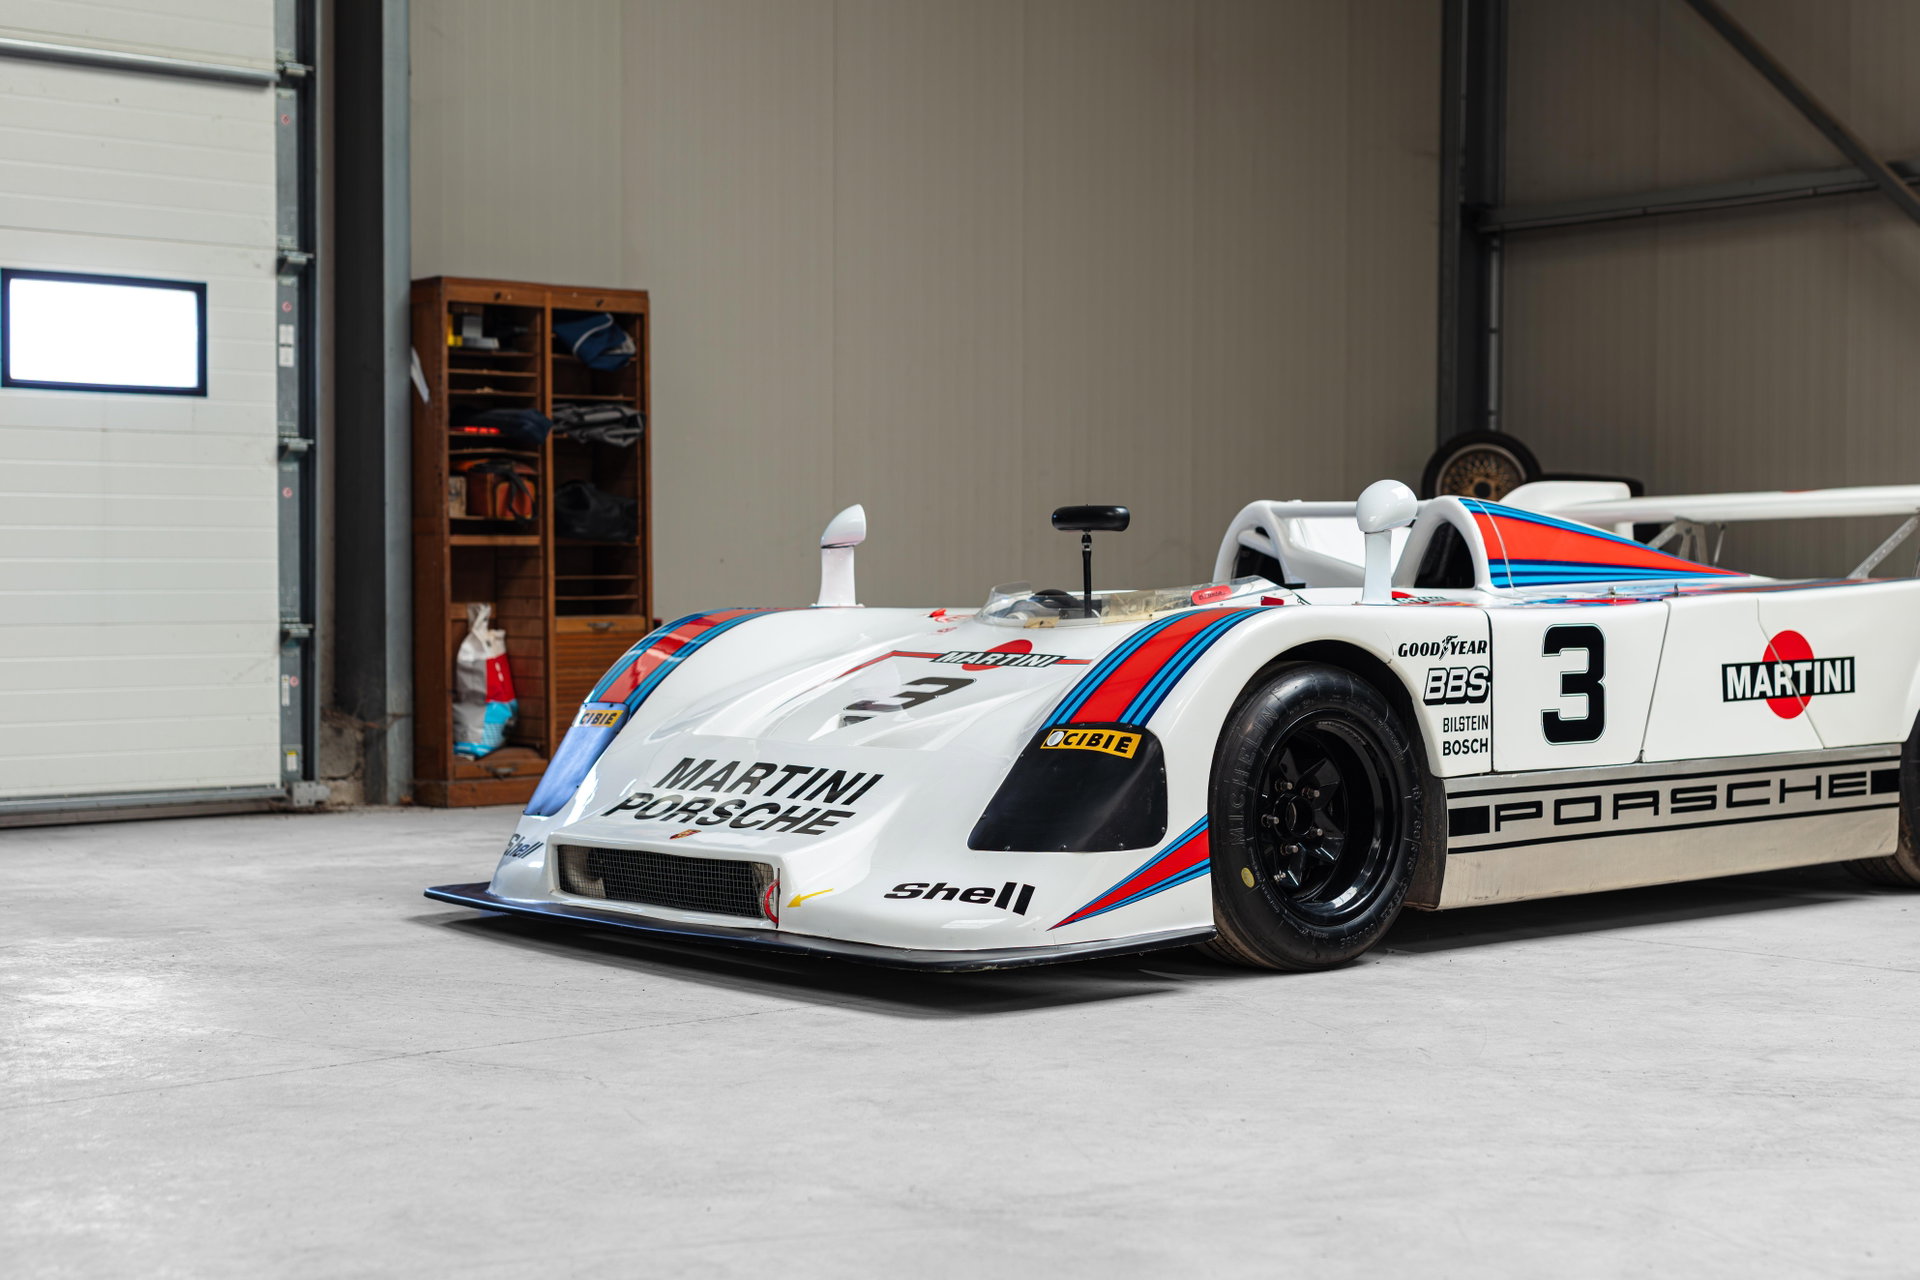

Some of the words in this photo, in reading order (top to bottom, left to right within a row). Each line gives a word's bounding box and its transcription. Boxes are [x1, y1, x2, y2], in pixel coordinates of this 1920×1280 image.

[936, 651, 1054, 668] MARTINI
[842, 676, 977, 713] 3
[1423, 665, 1491, 705] BBS
[1541, 623, 1606, 745] 3
[1725, 658, 1851, 700] MARTINI
[580, 712, 617, 725] CIBIE
[1442, 714, 1489, 733] BILSTEIN
[1062, 733, 1133, 754] CIBIE
[1442, 737, 1489, 757] BOSCH
[653, 757, 885, 806] MARTINI
[600, 792, 857, 836] PORSCHE
[1494, 771, 1867, 832] PORSCHE
[503, 833, 544, 859] Shell
[883, 881, 1036, 916] Shell
